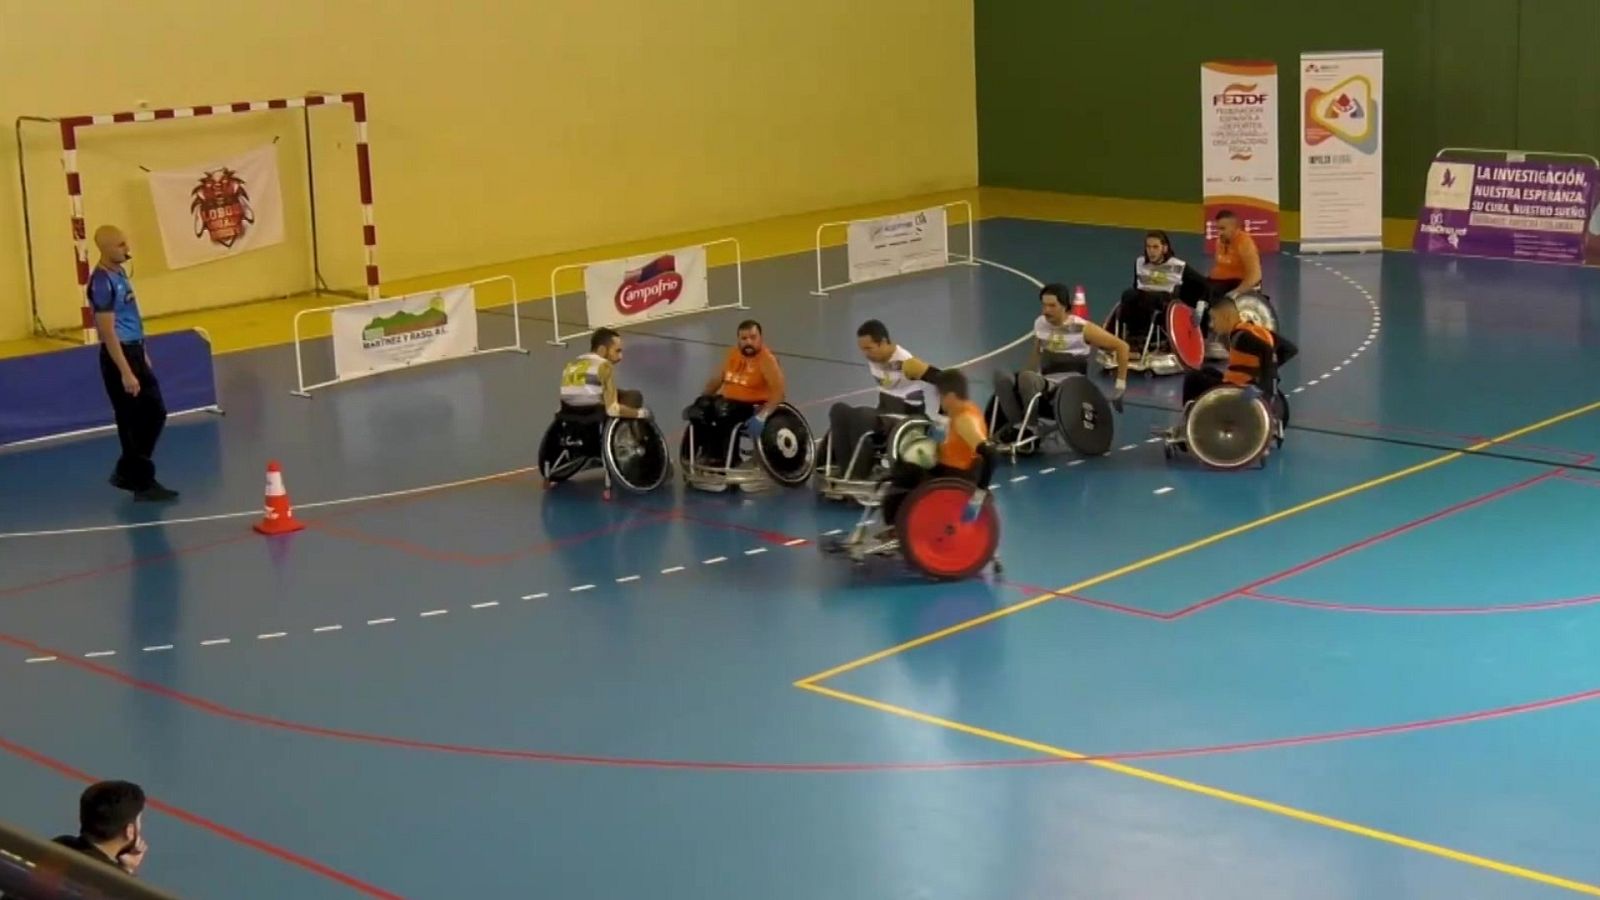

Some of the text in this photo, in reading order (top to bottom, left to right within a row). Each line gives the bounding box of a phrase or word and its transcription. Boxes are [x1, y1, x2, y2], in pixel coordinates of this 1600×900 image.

[1477, 166, 1587, 186] LA INVESTIGACIÓN,
[1474, 185, 1521, 200] NUESTRA
[1472, 201, 1484, 211] SU
[1513, 204, 1553, 216] NUESTRO
[402, 334, 409, 342] Y
